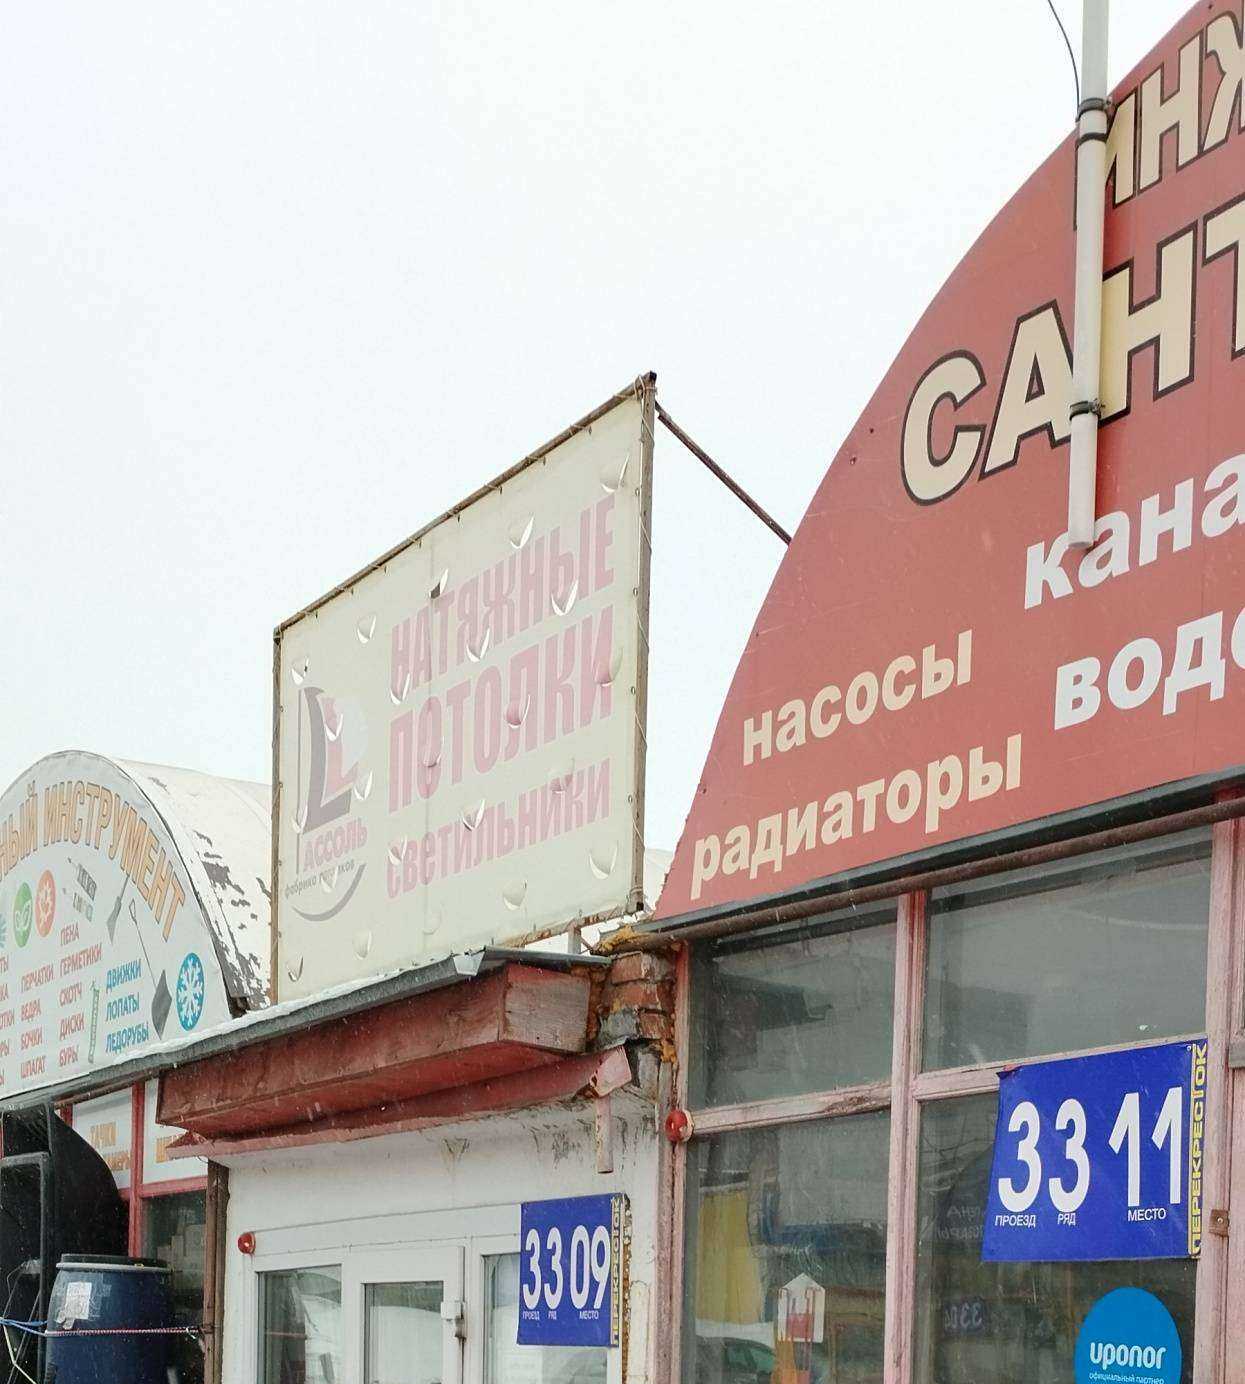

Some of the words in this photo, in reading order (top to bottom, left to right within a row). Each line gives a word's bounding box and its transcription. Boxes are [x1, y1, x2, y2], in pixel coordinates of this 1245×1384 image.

[1024, 453, 1245, 609] кана
[390, 494, 615, 697] НАТЯЖНЫЕ
[1054, 606, 1245, 730] вод
[389, 605, 614, 813] ПОТОЛКИ
[743, 629, 972, 766] насосы
[387, 758, 610, 899] светильники
[690, 733, 1022, 900] радиаторы
[43, 780, 186, 943] ИНСТРУМЕНТ
[303, 817, 368, 873] АССОЛЬ
[59, 943, 102, 976] ГЕРМЕТИКИ
[105, 958, 142, 993] ДВИЖКИ
[21, 964, 54, 992] ПЕРЧАТКИ
[59, 982, 82, 1007] СКОТЧ
[20, 999, 42, 1023] ВЕДРА
[105, 992, 140, 1021] ЛОПАТЫ
[20, 1027, 43, 1050] БОЧКИ
[59, 1012, 85, 1041] ДИСКИ
[105, 1021, 150, 1054] ЛЕДОРУБЫ
[20, 1055, 46, 1079] ШПАГАТ
[59, 1045, 79, 1067] БУРЫ
[1191, 1043, 1208, 1254] ПЕРЕКРЕСТОК
[994, 1214, 1036, 1228] ПРОЕЗД
[1057, 1212, 1076, 1226] РЯД
[1127, 1207, 1167, 1222] МЕСТО
[522, 1310, 540, 1320] ПРОЕЗД
[579, 1310, 599, 1320] МЕСТО
[1089, 1342, 1167, 1370] uponor
[1089, 1371, 1135, 1384] официальный
